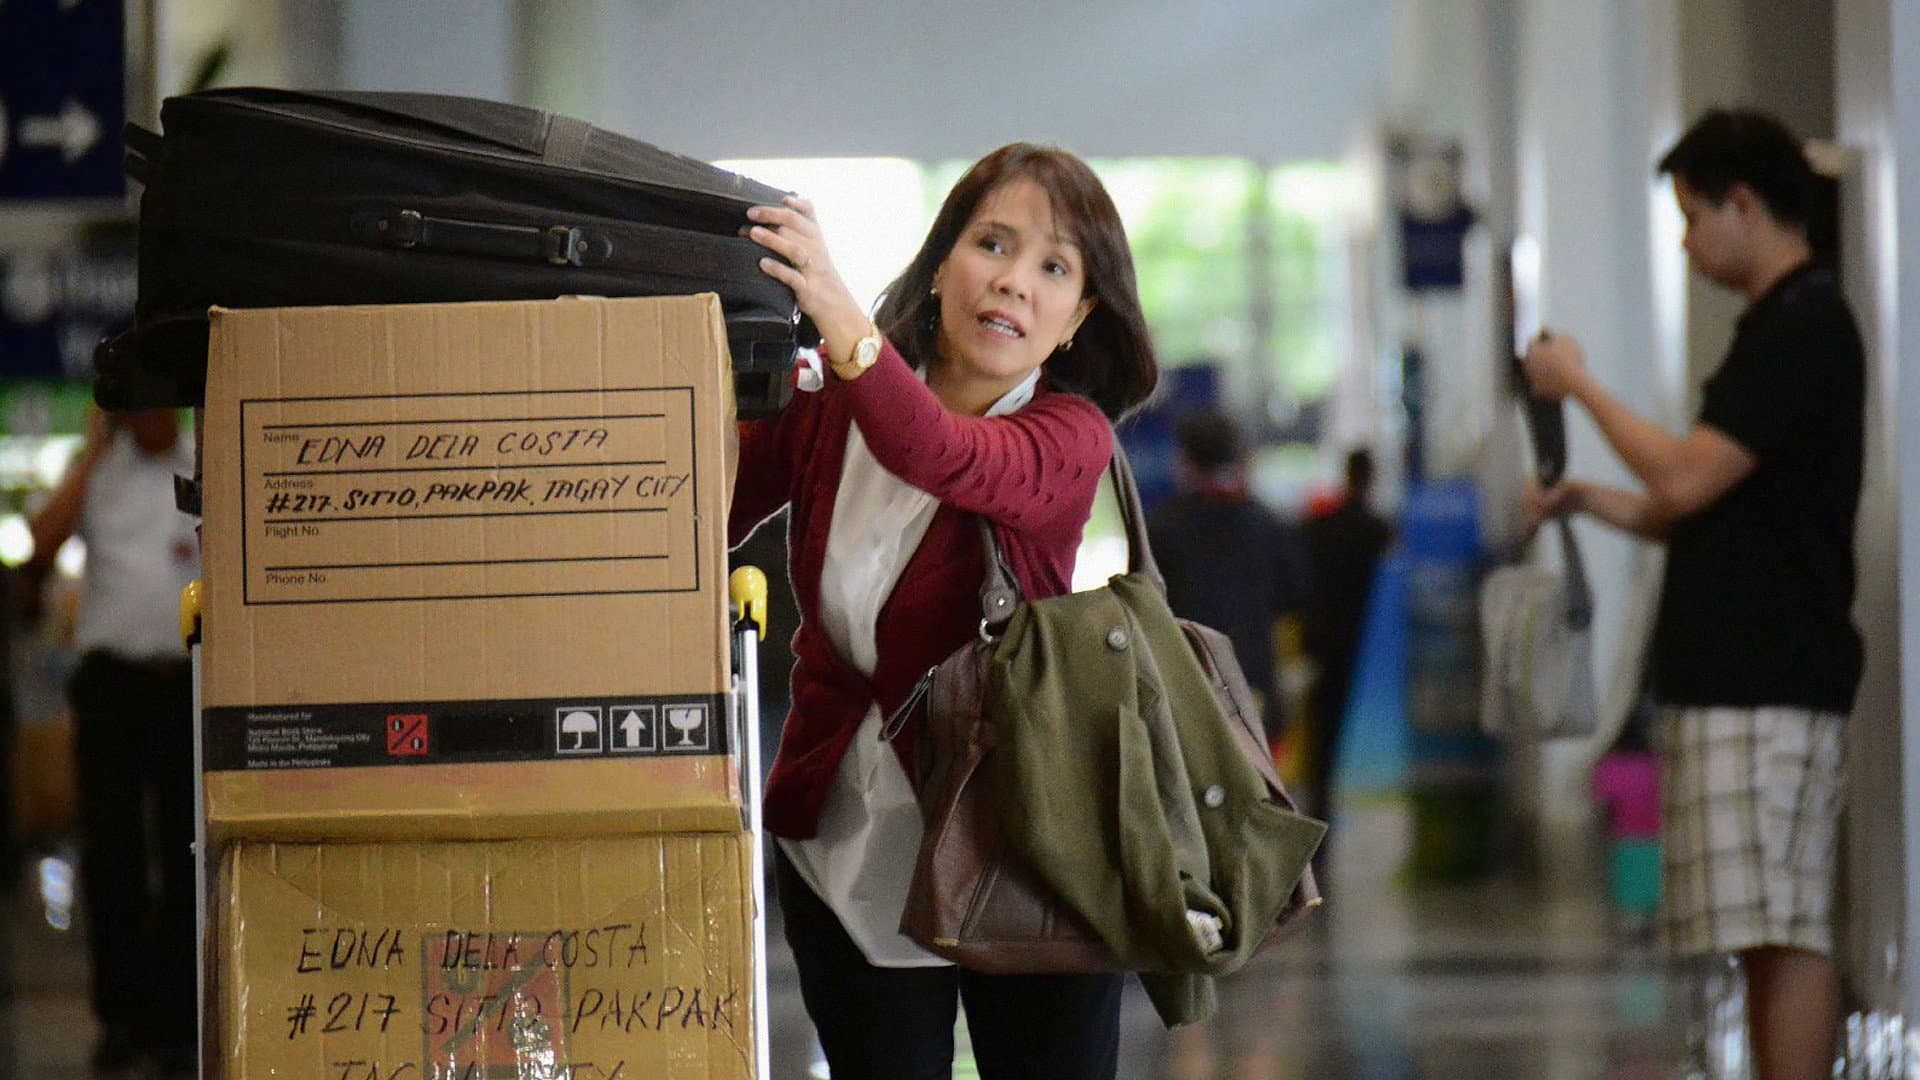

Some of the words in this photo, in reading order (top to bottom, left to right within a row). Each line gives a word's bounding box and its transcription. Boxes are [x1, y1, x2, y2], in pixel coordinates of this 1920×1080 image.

[263, 432, 299, 443] Name
[297, 434, 386, 465] EDNA
[406, 432, 478, 461] DELA
[498, 428, 608, 455] COSTA
[264, 479, 313, 489] Address
[543, 475, 630, 503] TAGAY
[636, 473, 690, 498] CITY
[264, 525, 298, 539] Flight
[265, 573, 305, 585] Phone
[296, 926, 405, 974] EDNA
[442, 928, 521, 970] DELA
[542, 922, 649, 970] COSTA
[287, 992, 401, 1040] #217
[426, 992, 542, 1035] SITIO
[571, 986, 737, 1034] PAKPAK
